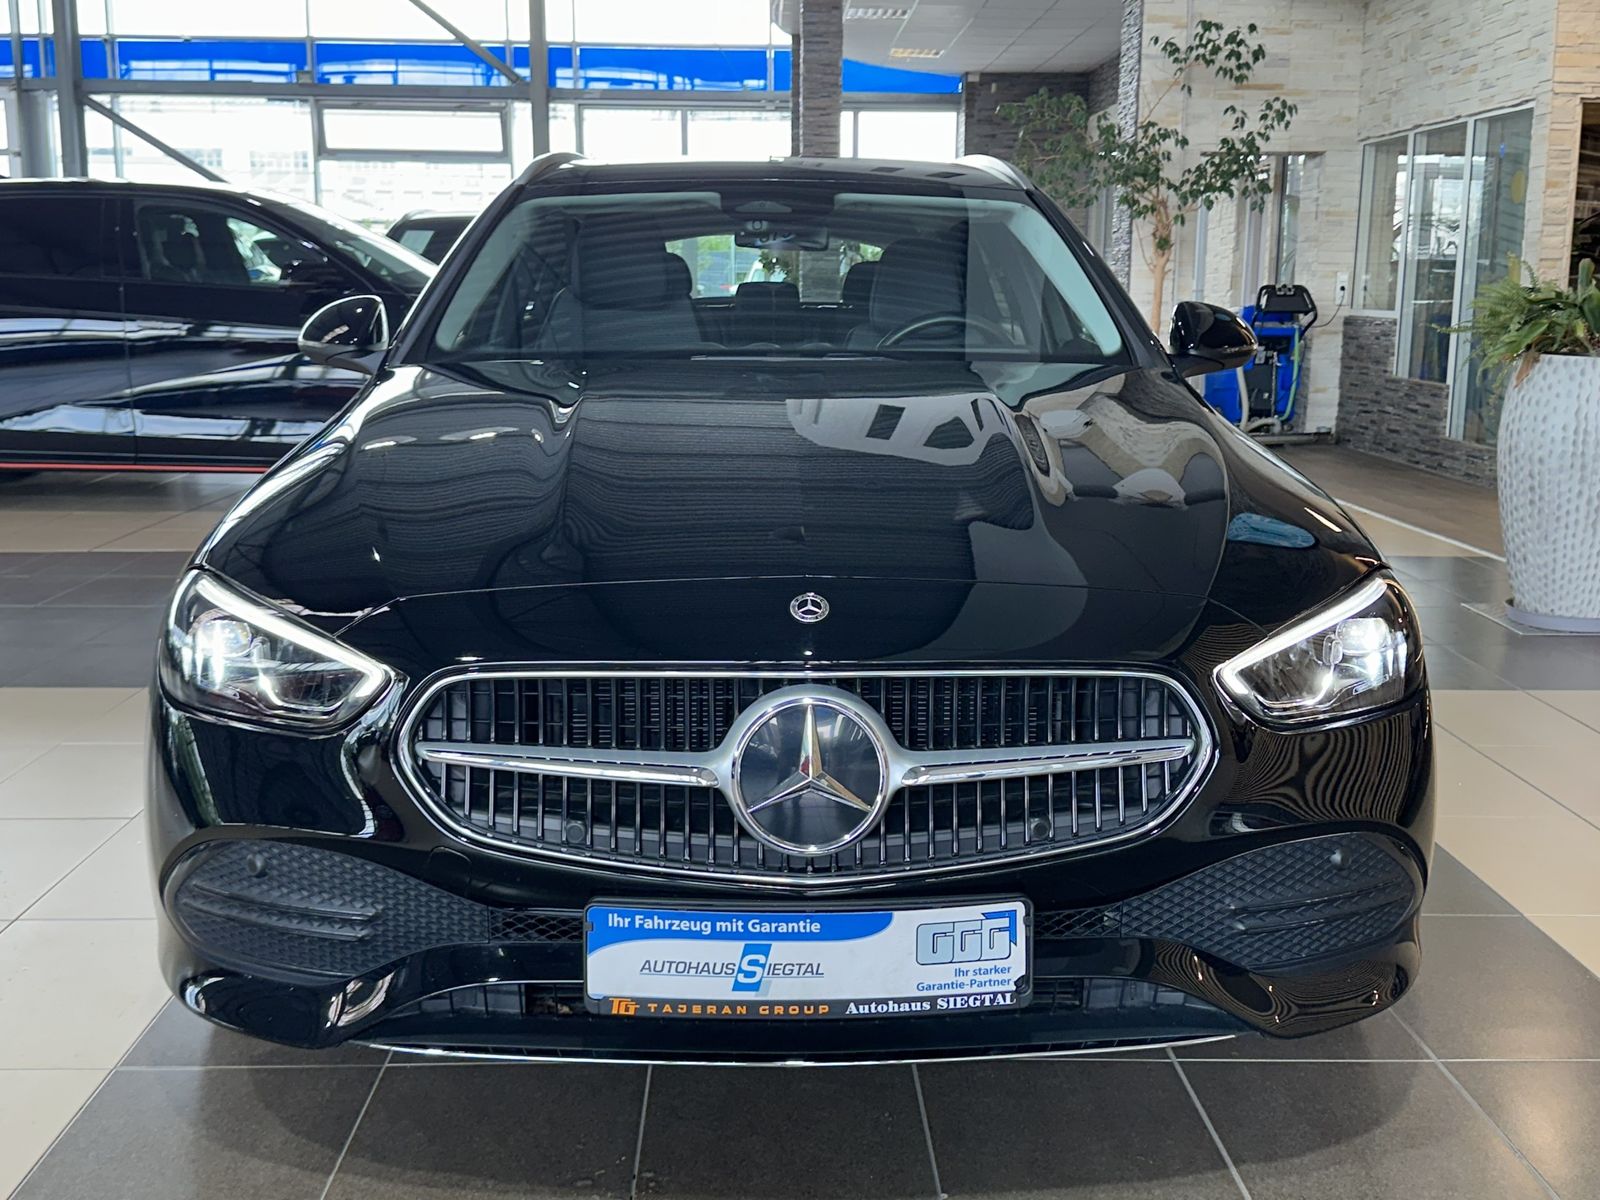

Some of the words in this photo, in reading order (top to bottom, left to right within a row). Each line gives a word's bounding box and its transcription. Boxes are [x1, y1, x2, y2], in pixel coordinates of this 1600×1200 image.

[609, 915, 631, 929] Ihr
[635, 915, 710, 934] Fahrzeug
[715, 918, 744, 933] mit
[748, 918, 820, 934] Garantie
[640, 960, 735, 976] AUTOHAUS
[954, 968, 970, 977] Ihr
[974, 965, 1012, 976] starker
[916, 977, 1012, 992] Garantie-Partner
[648, 1004, 746, 1015] TAJERAN
[759, 1005, 830, 1015] GROUP
[846, 1000, 931, 1015] Autohaus
[937, 993, 1016, 1010] SIEGTAL
